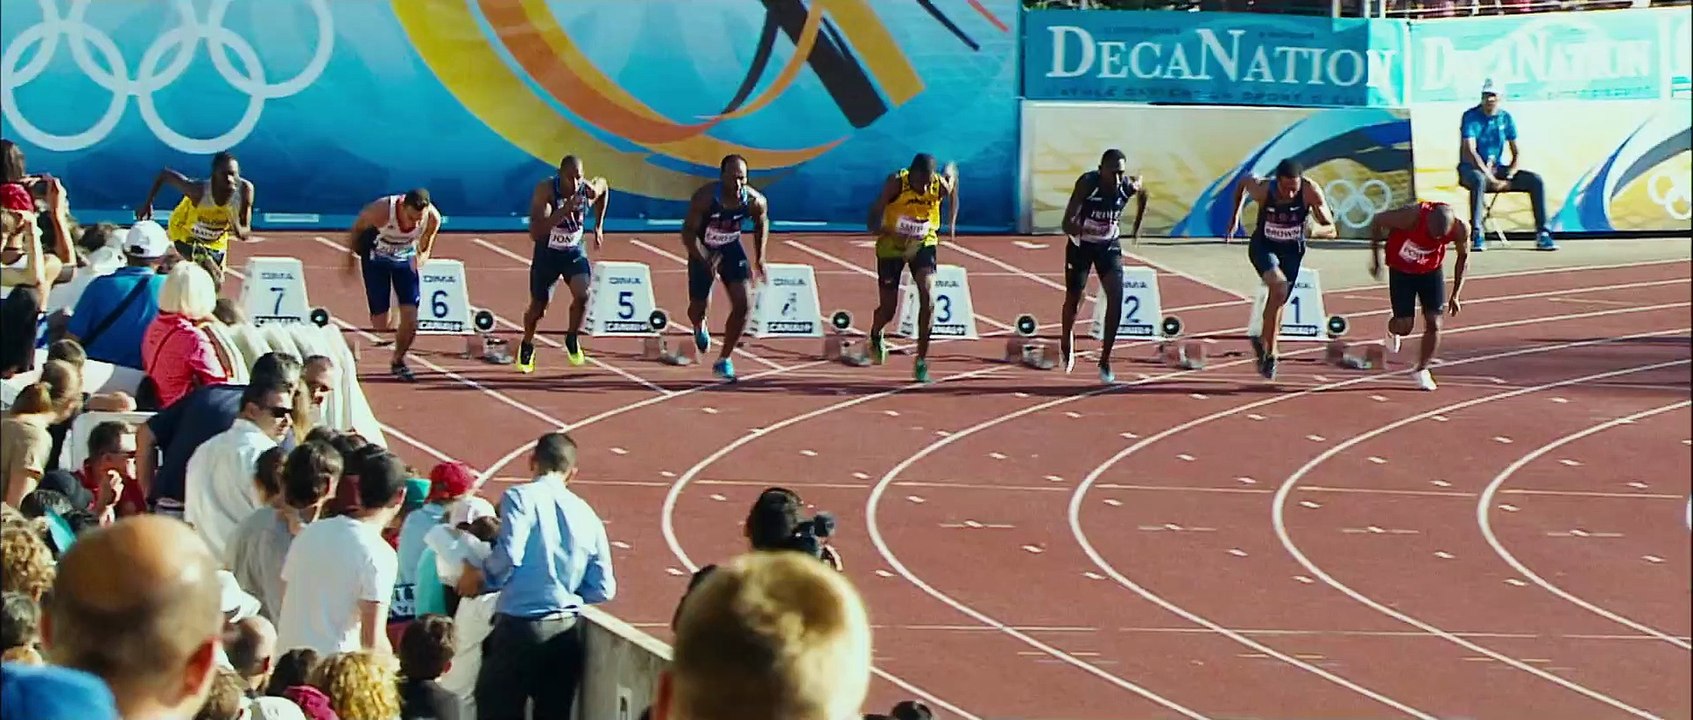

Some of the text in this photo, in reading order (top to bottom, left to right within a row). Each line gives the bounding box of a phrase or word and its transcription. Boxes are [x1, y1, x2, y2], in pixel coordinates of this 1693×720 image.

[1265, 227, 1300, 238] BROWN
[269, 286, 286, 315] 7
[431, 289, 449, 319] 6
[617, 291, 635, 320] 5
[935, 294, 951, 323] 3
[1124, 295, 1140, 324] 2
[1290, 296, 1301, 324] 1
